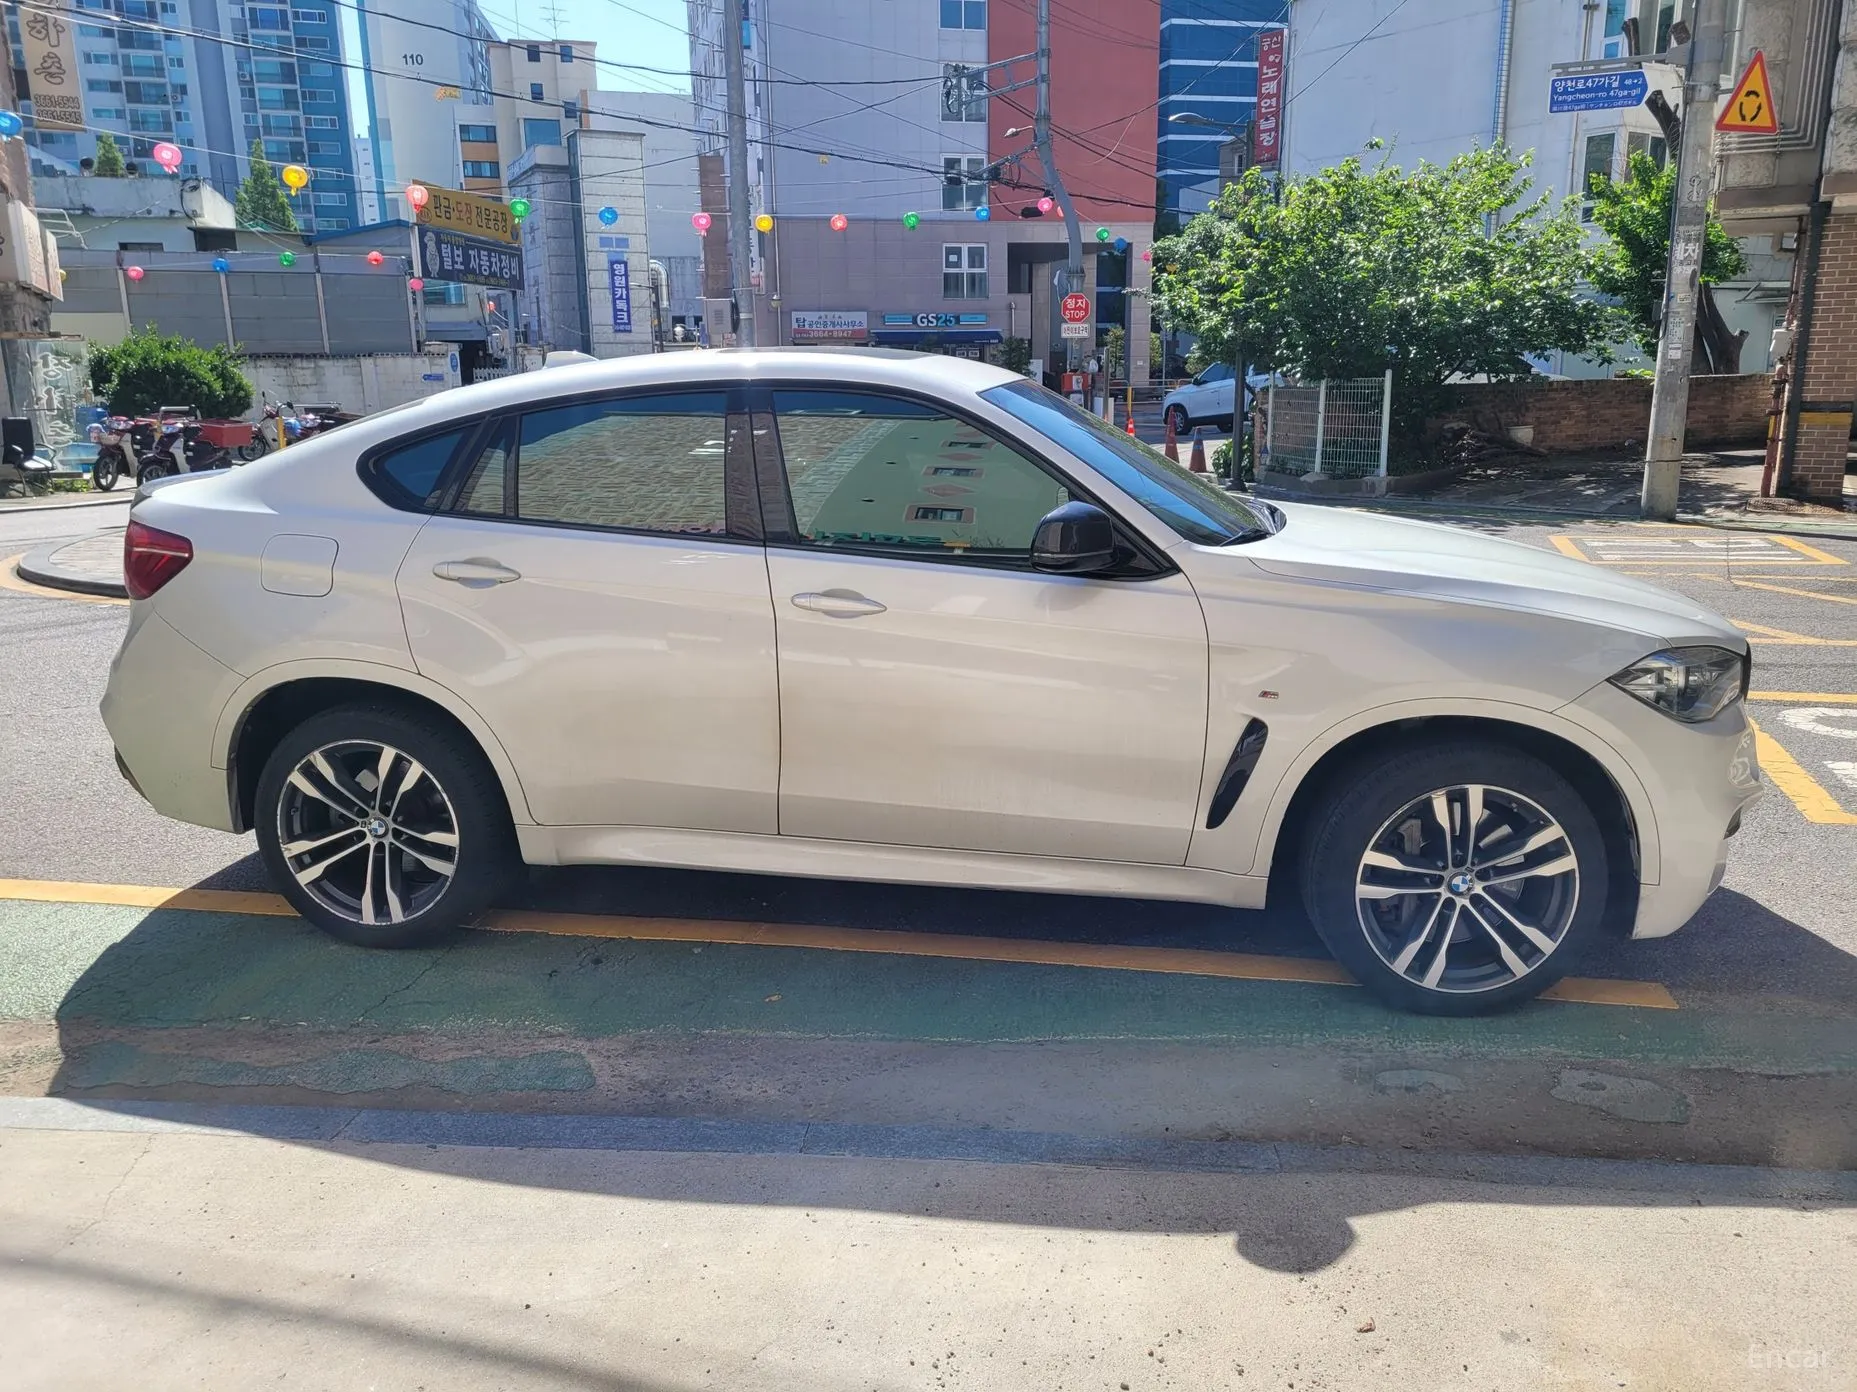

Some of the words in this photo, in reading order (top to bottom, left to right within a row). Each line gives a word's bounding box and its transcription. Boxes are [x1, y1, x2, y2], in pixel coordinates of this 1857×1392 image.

[402, 53, 424, 66] 110
[1554, 75, 1620, 93] 양천로47가길
[1553, 91, 1607, 102] Yangcheon-ro
[1609, 87, 1641, 97] 47ga-gil
[1260, 65, 1278, 146] 노래연습장
[475, 205, 508, 234] 전문공장
[441, 243, 464, 270] 털보
[469, 247, 520, 281] 자동차정비
[1066, 298, 1086, 309] 정지
[916, 313, 955, 327] GS25
[1065, 310, 1086, 319] STOP
